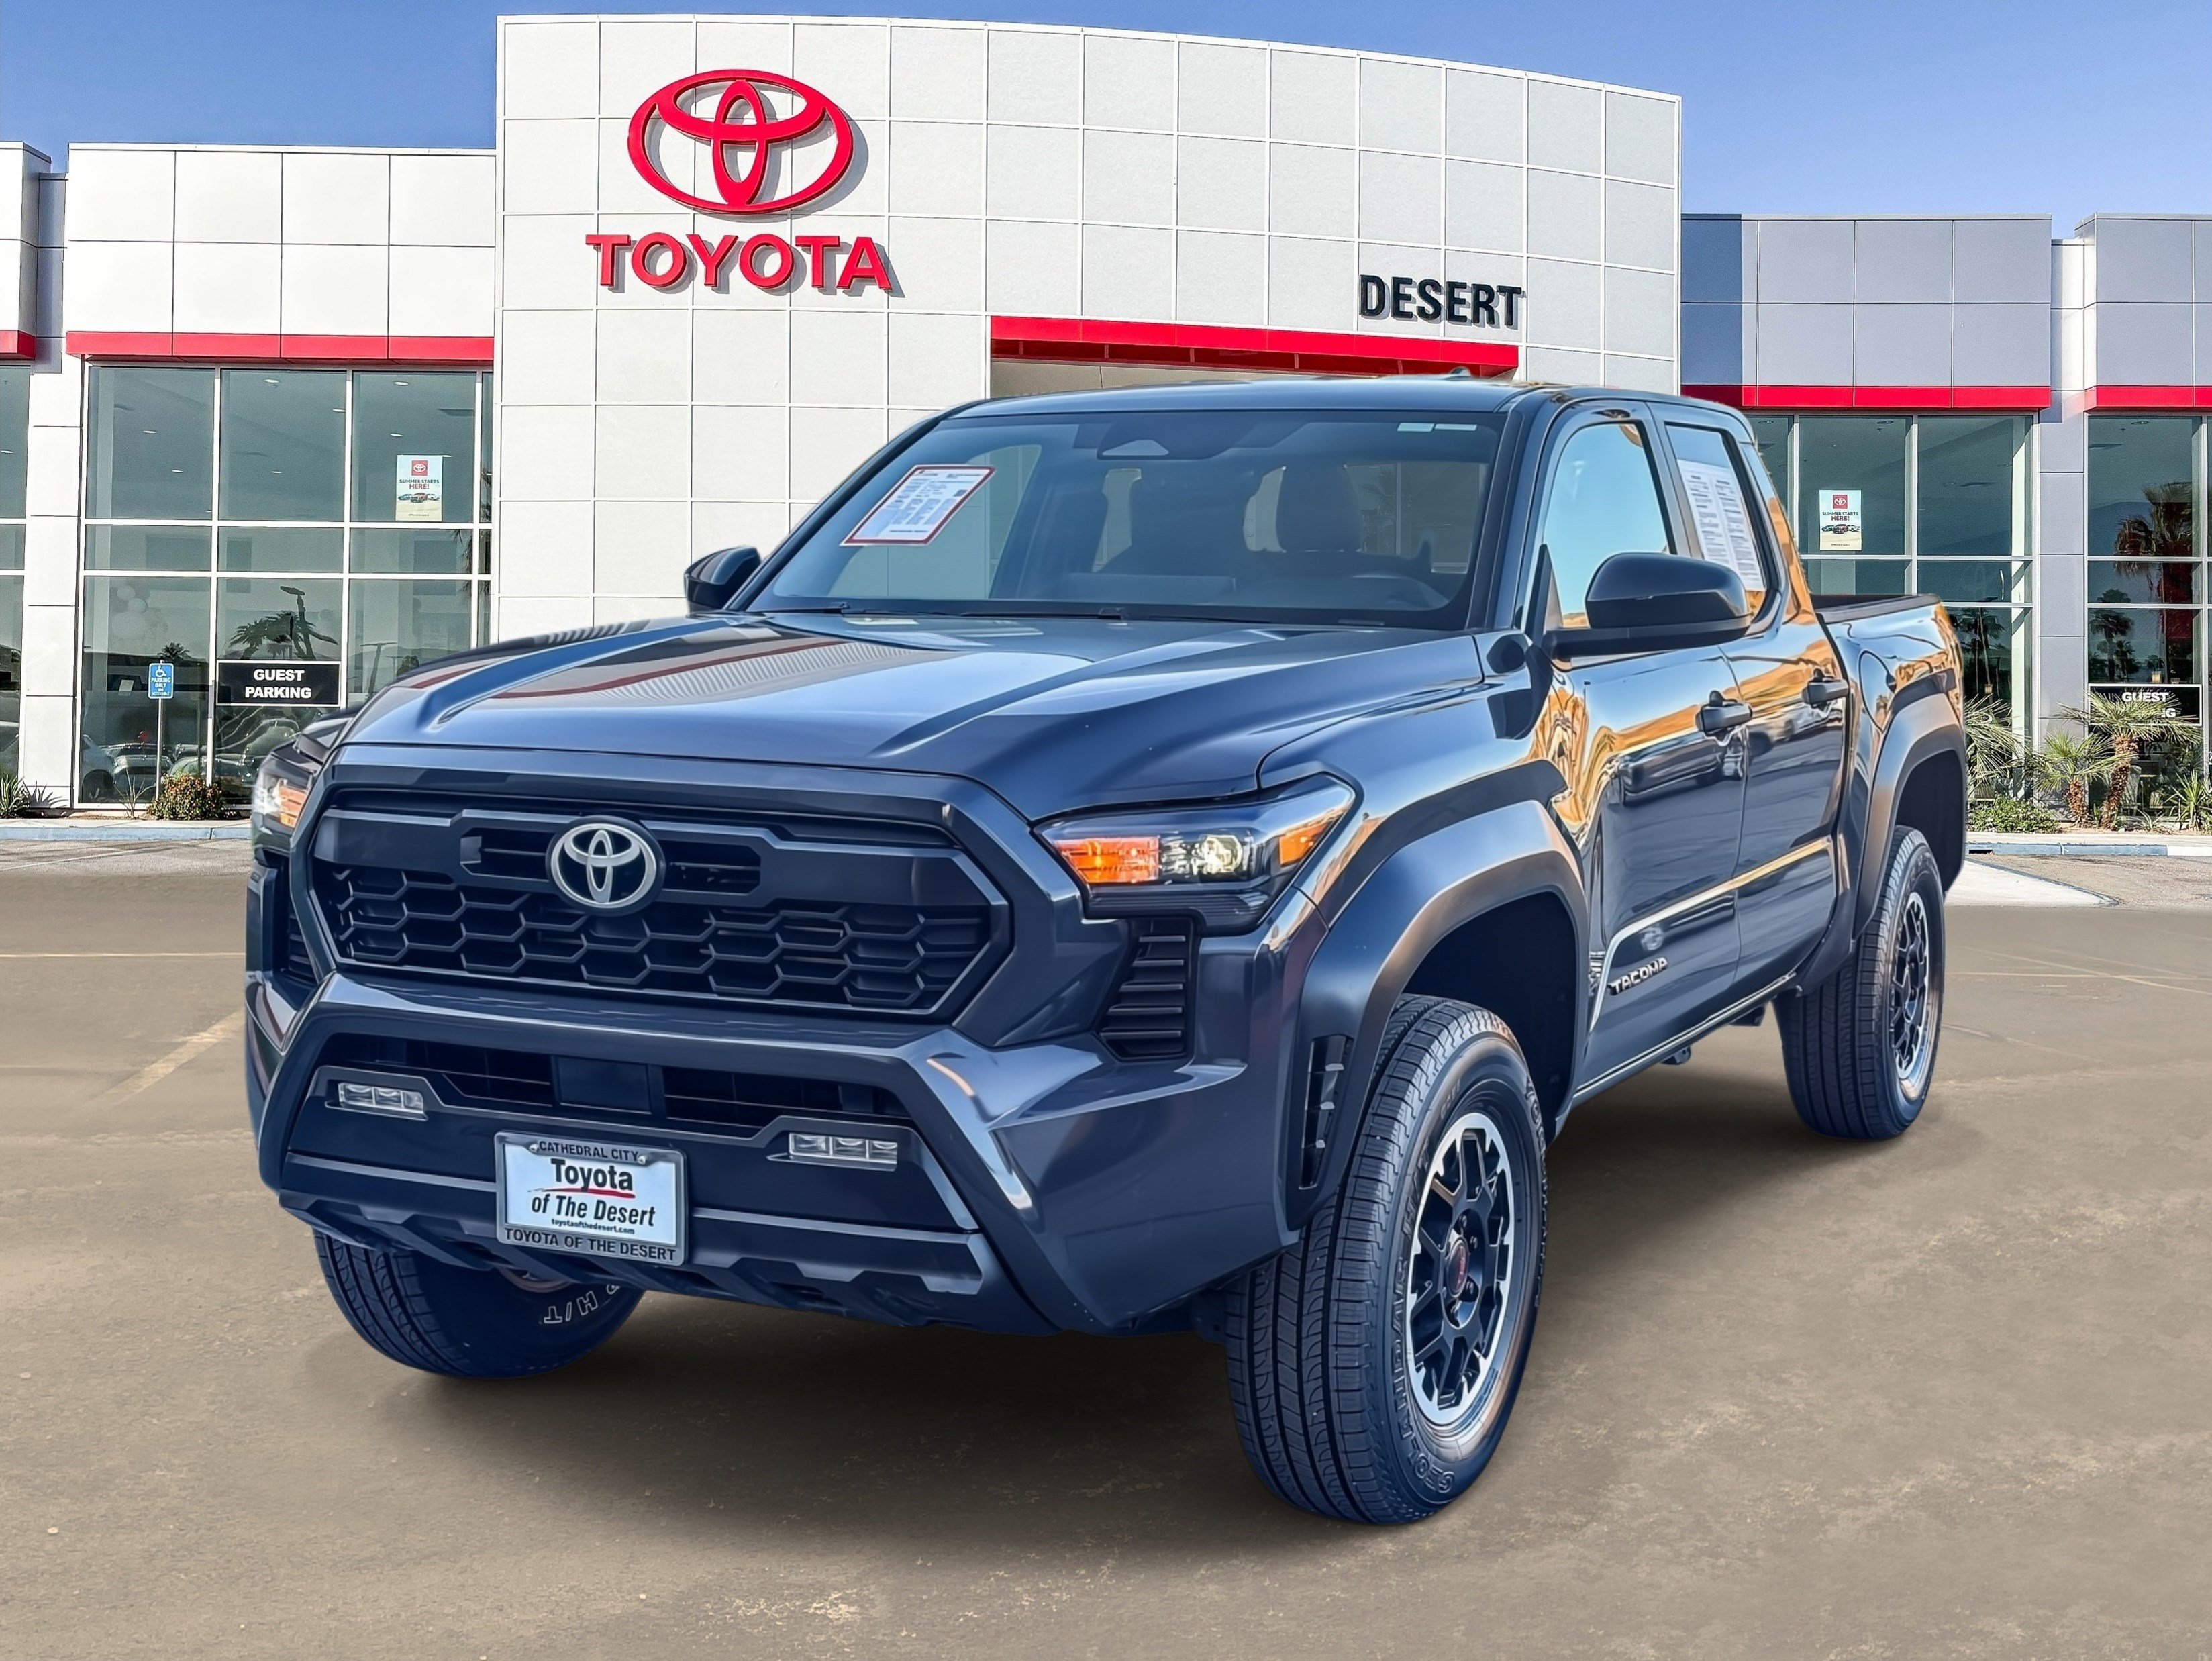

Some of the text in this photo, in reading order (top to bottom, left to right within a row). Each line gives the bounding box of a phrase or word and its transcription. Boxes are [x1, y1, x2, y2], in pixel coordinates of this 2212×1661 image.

[585, 232, 892, 290] TOYOTA
[1359, 274, 1522, 327] DESERT
[253, 669, 305, 681] GUEST
[245, 686, 312, 699] PARKING
[2121, 692, 2169, 703] GUEST
[1607, 957, 1668, 994] TACOMA
[539, 1141, 638, 1162] CATHEDRAL CITY
[550, 1158, 633, 1192] Toyota
[532, 1194, 656, 1227] of The Desert
[551, 1218, 635, 1234] toyotaofthedesert.com
[504, 1228, 676, 1261] TOYOTA OF THE DESERT
[544, 1290, 599, 1324] H/T
